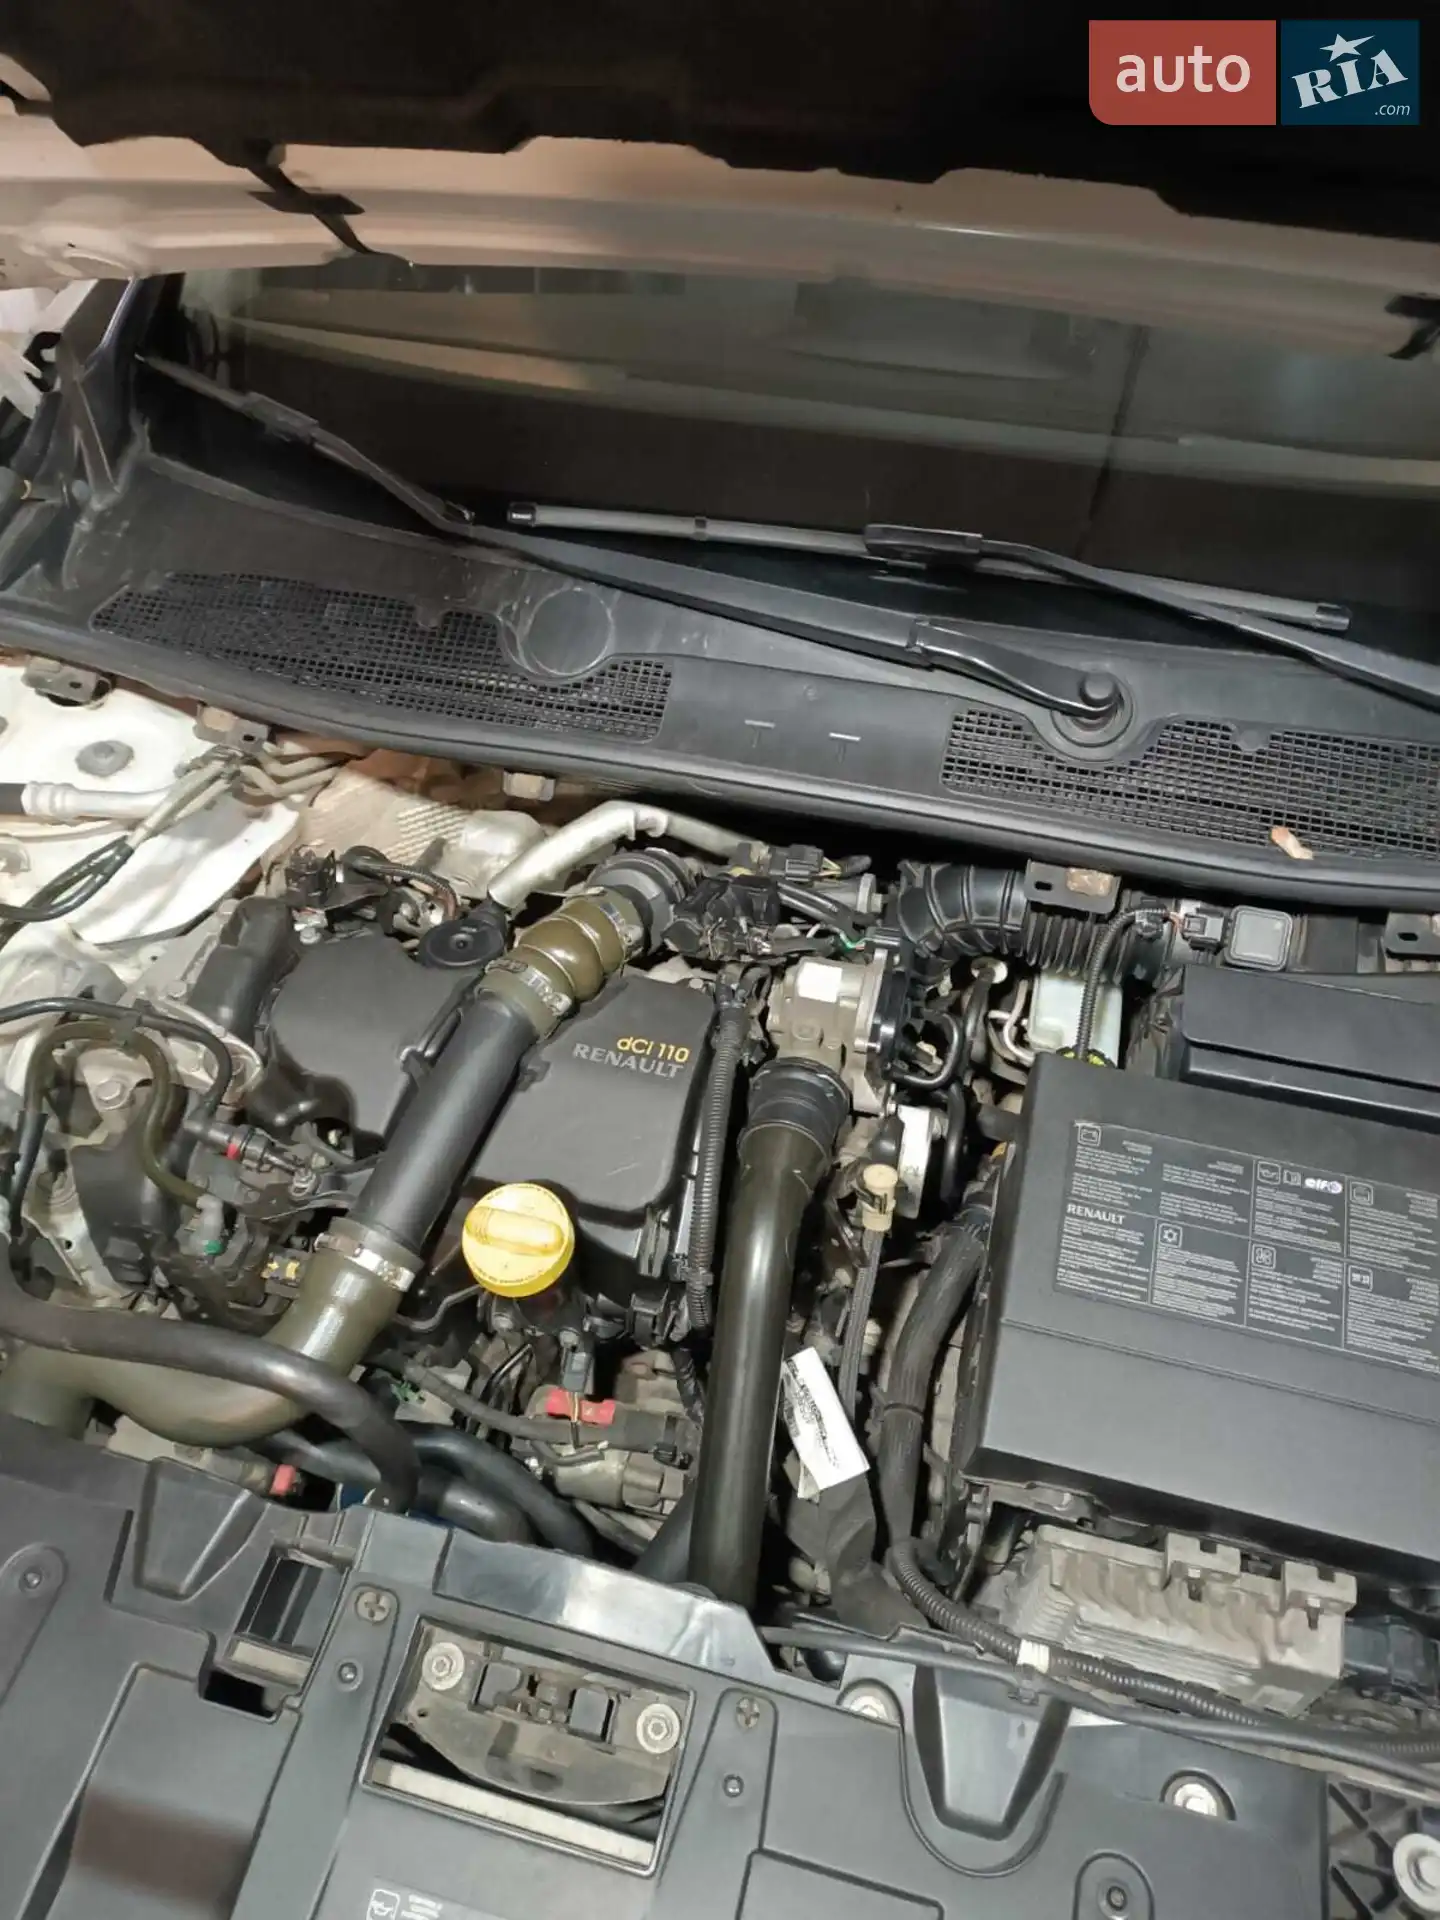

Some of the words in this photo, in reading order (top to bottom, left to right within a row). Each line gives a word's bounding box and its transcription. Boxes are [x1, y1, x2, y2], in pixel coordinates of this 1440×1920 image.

[572, 1043, 684, 1079] RENAULT
[658, 1043, 690, 1063] 110
[1066, 1203, 1126, 1224] RENAULT
